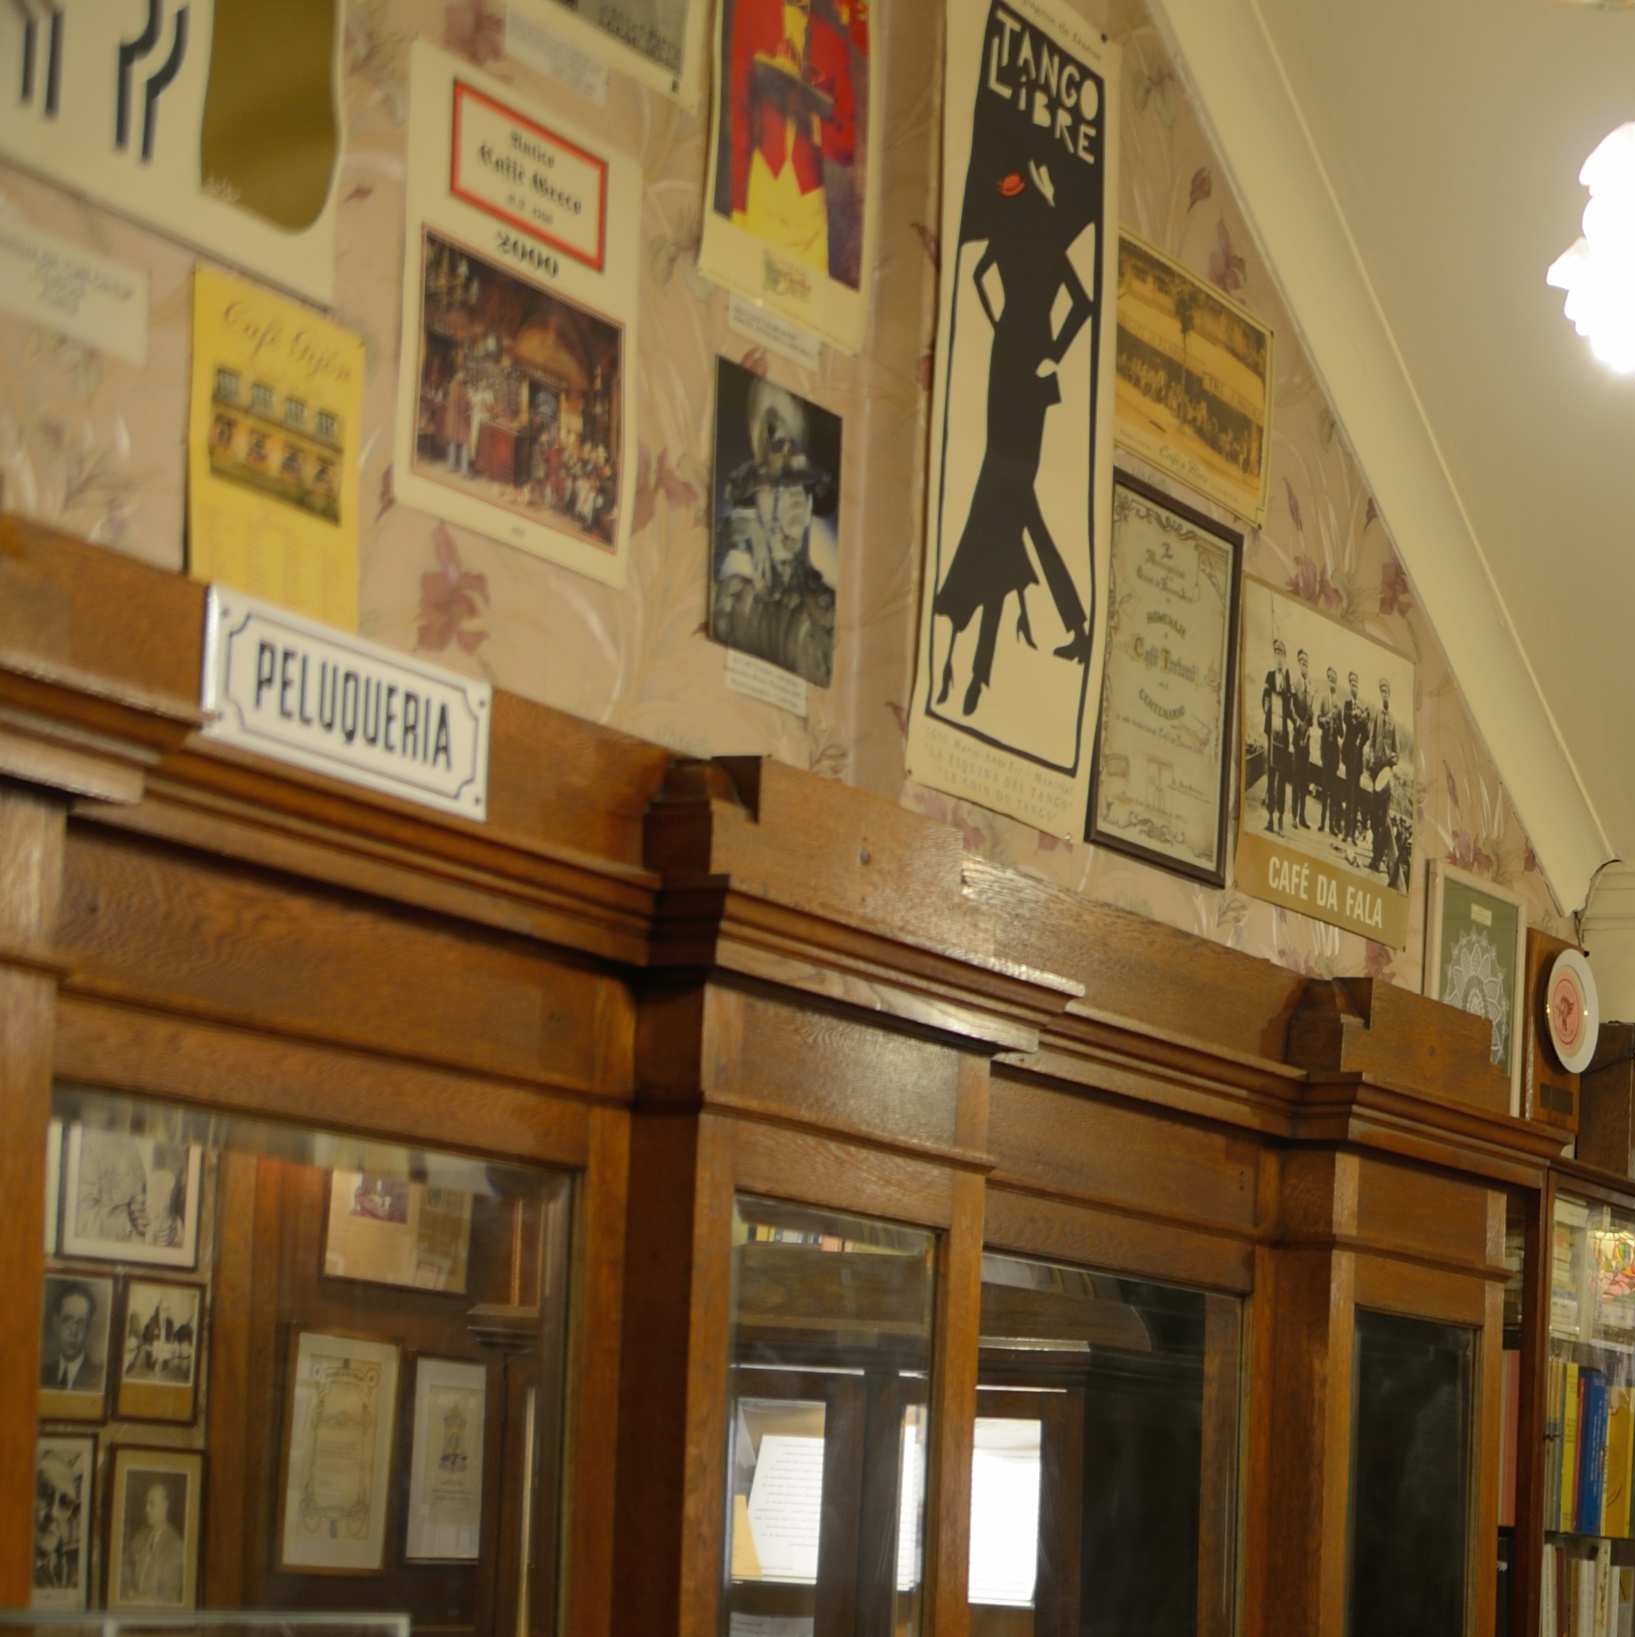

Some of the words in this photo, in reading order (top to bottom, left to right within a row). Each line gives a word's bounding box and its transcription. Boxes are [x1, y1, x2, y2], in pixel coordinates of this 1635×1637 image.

[996, 8, 1098, 121] TANGO
[255, 639, 452, 773] PELUQUERIA
[1268, 856, 1310, 901] CAFÉ
[1316, 874, 1338, 912] DA
[1346, 886, 1383, 929] FALA
